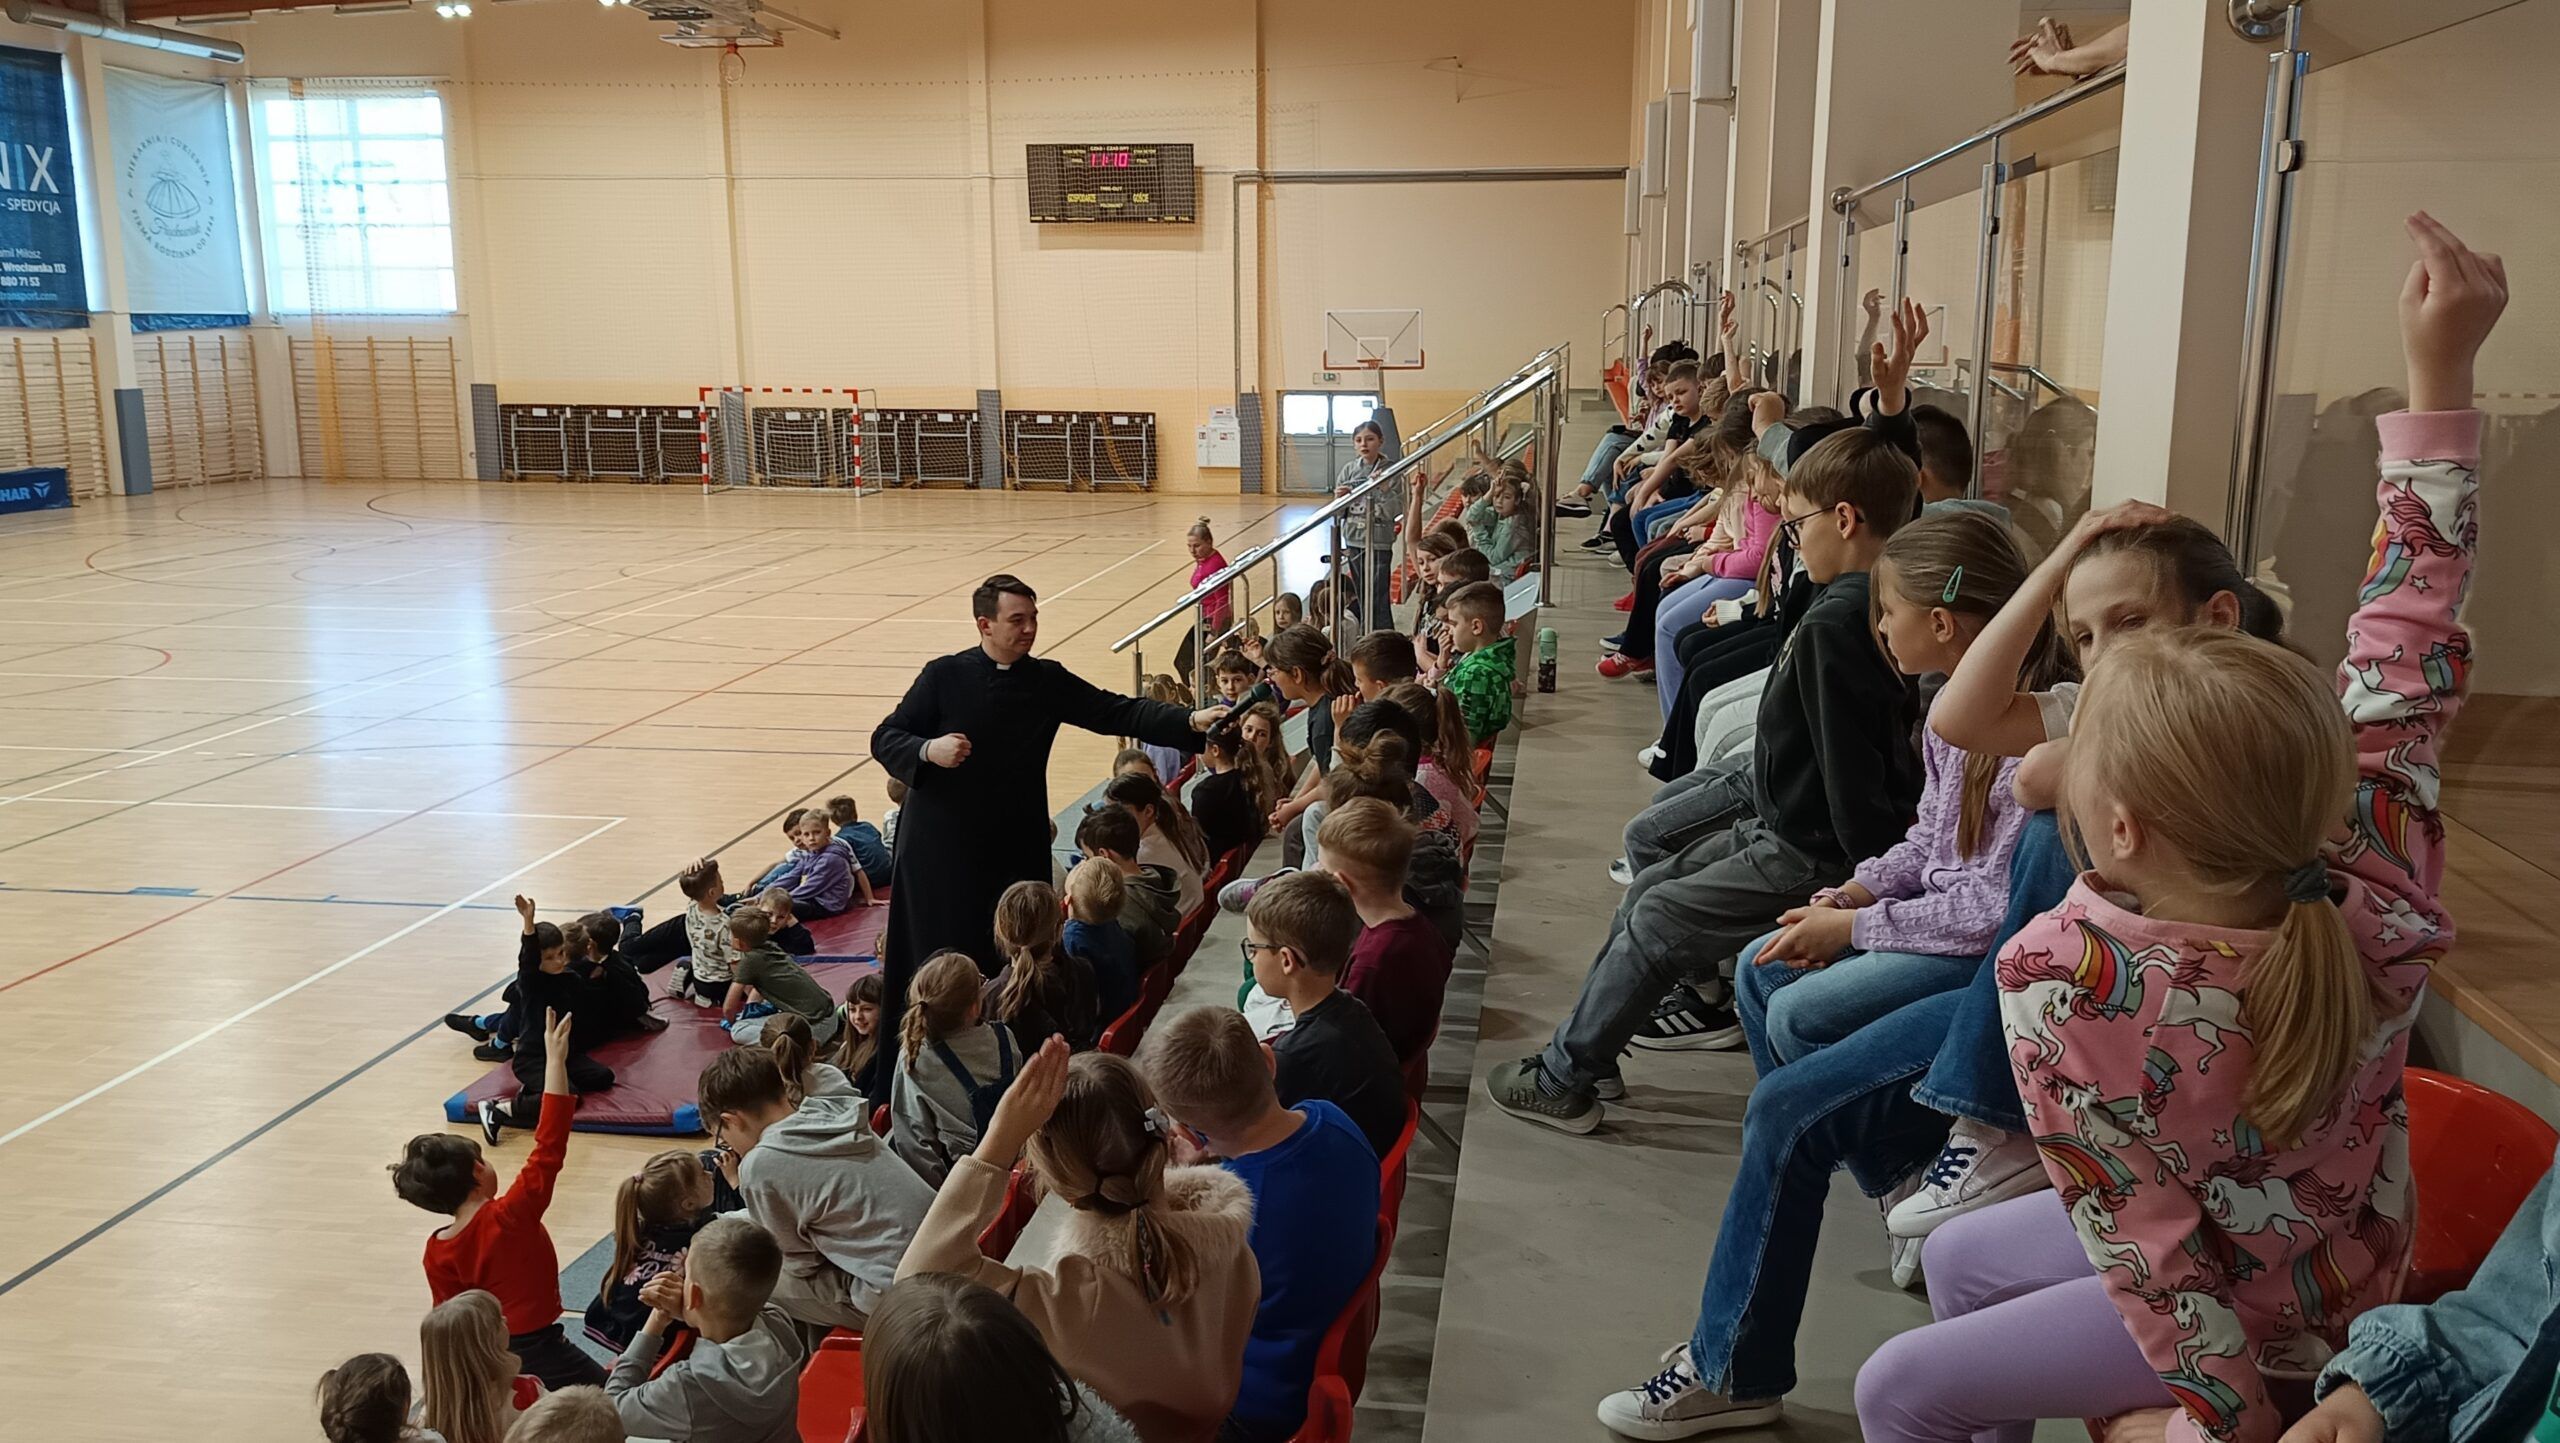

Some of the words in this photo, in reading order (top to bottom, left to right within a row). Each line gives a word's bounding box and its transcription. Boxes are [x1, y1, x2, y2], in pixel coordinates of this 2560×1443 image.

[170, 137, 210, 186] CUKIERNIA
[1090, 152, 1129, 168] 11:10
[6, 197, 62, 216] SPEDYCJA
